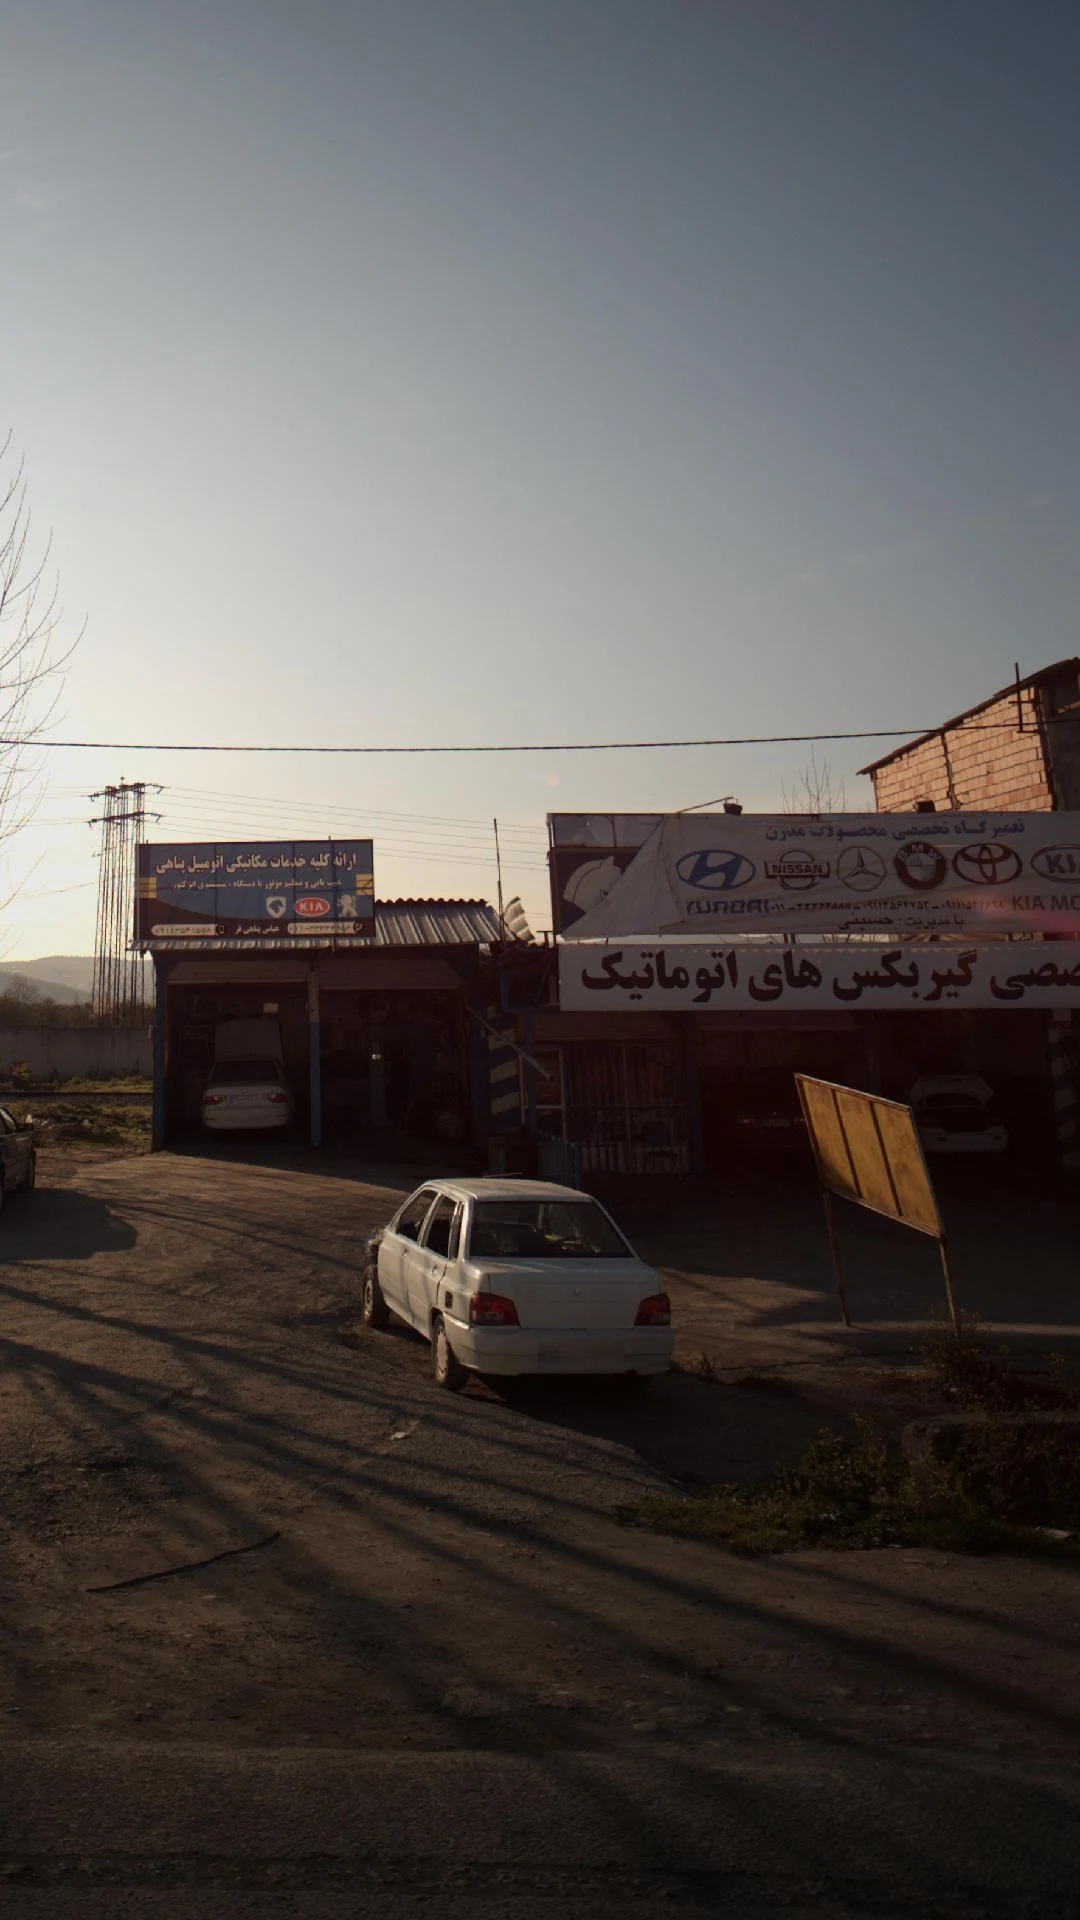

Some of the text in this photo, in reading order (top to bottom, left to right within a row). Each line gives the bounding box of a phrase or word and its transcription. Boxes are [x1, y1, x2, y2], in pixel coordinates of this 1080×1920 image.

[765, 826, 806, 841] مدرن
[156, 856, 185, 874] پناهی
[187, 855, 224, 873] اتومبیل
[226, 853, 268, 873] مکانیکی
[270, 853, 306, 869] خدمات
[310, 852, 330, 871] کلیه
[771, 864, 823, 874] NISSAN
[1045, 853, 1080, 874] KI
[299, 902, 323, 912] KIA
[1012, 895, 1044, 911] KIA
[838, 916, 893, 931] حسینی
[905, 915, 949, 930] مدیریت
[580, 949, 1080, 1003] صصی گیربکس های اتوماتیک
